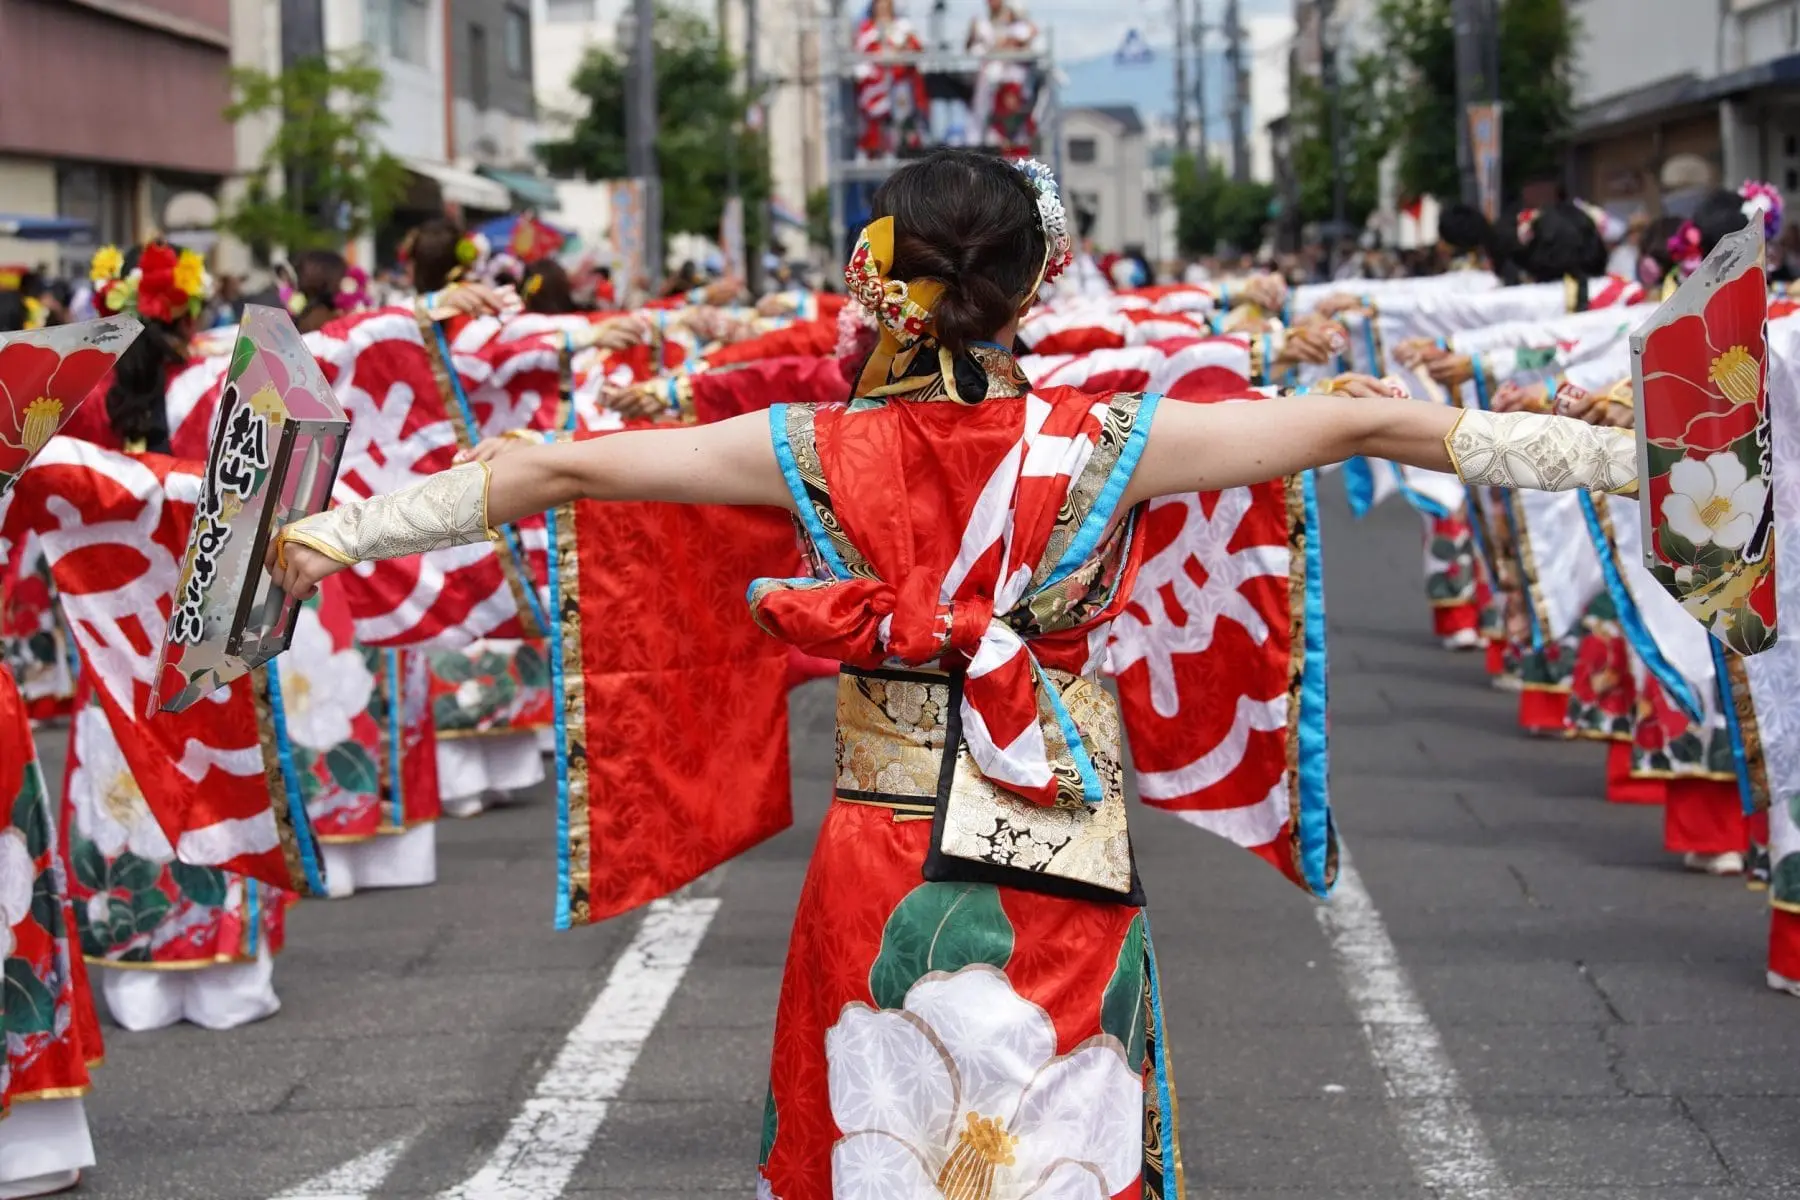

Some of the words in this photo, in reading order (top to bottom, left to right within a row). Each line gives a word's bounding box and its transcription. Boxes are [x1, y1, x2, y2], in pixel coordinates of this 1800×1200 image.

[173, 404, 267, 642] 松山よさこい
